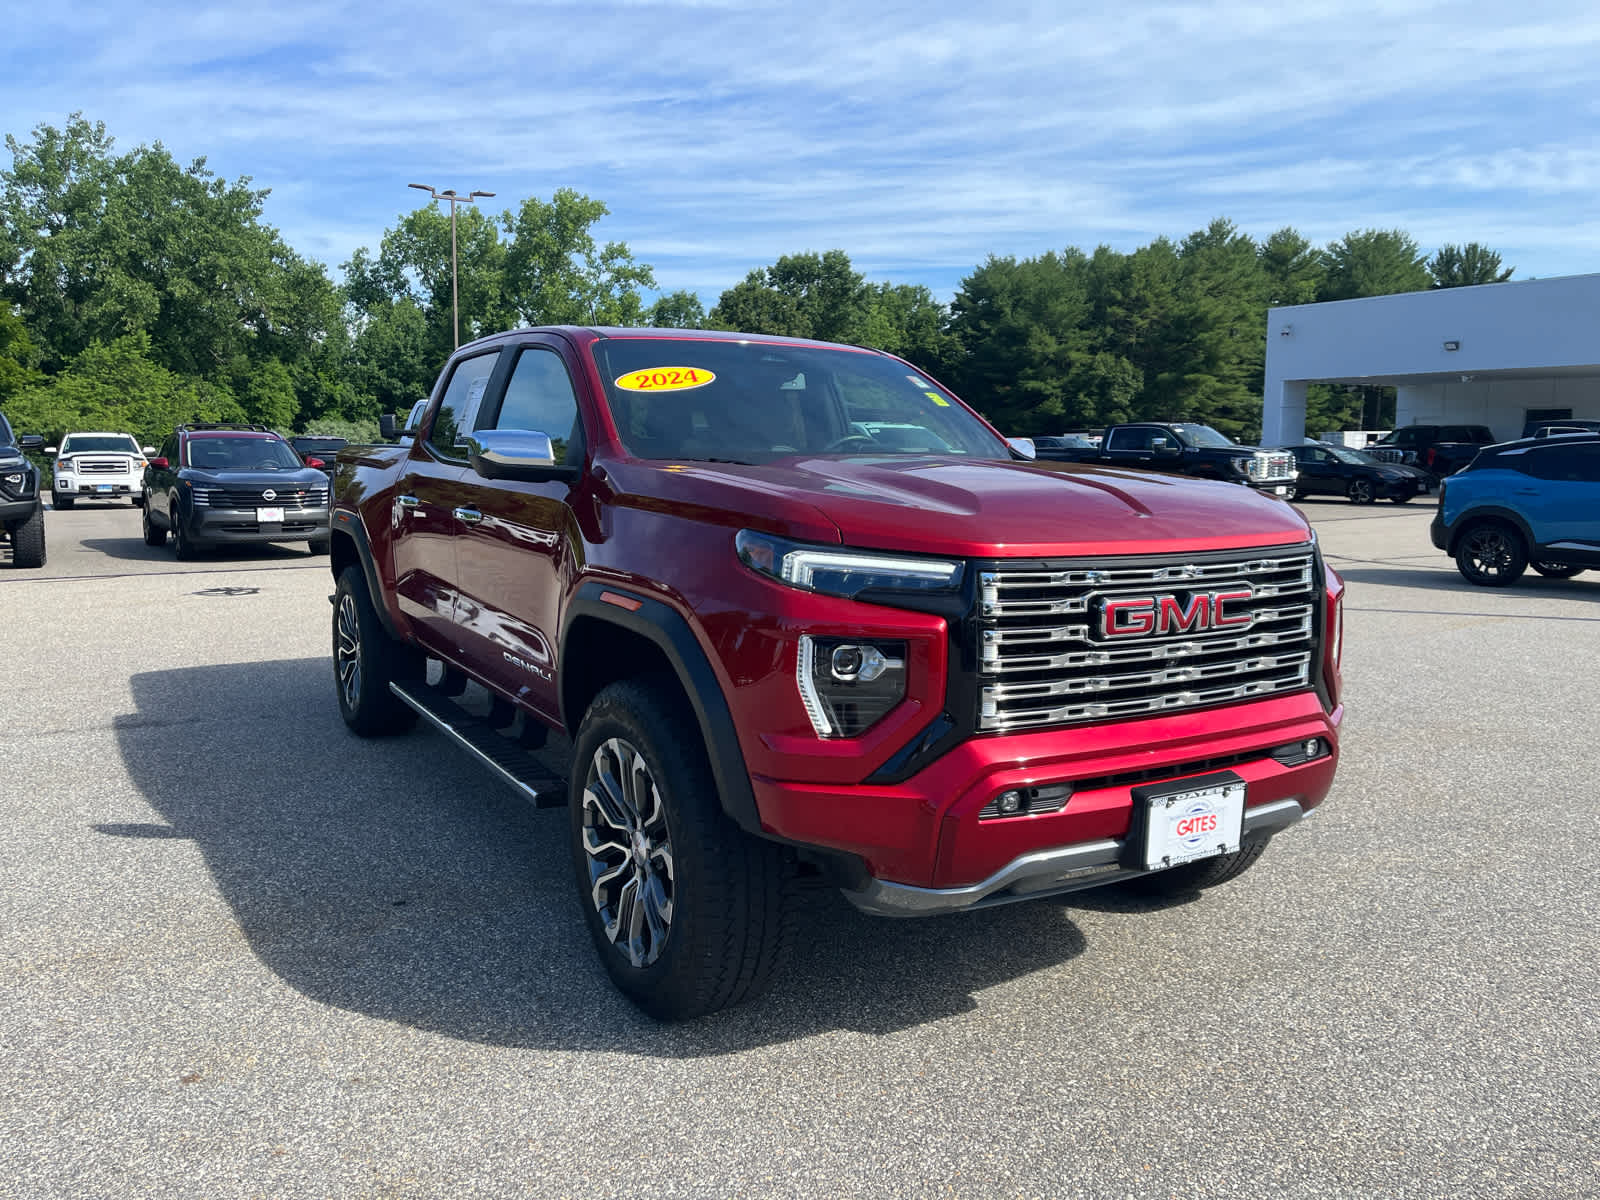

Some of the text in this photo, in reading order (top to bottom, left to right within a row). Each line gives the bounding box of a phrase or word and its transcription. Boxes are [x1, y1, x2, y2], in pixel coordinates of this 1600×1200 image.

[635, 369, 699, 389] 2024
[1101, 590, 1252, 638] GMC
[503, 651, 552, 682] DENALI
[1176, 815, 1217, 836] GATES
